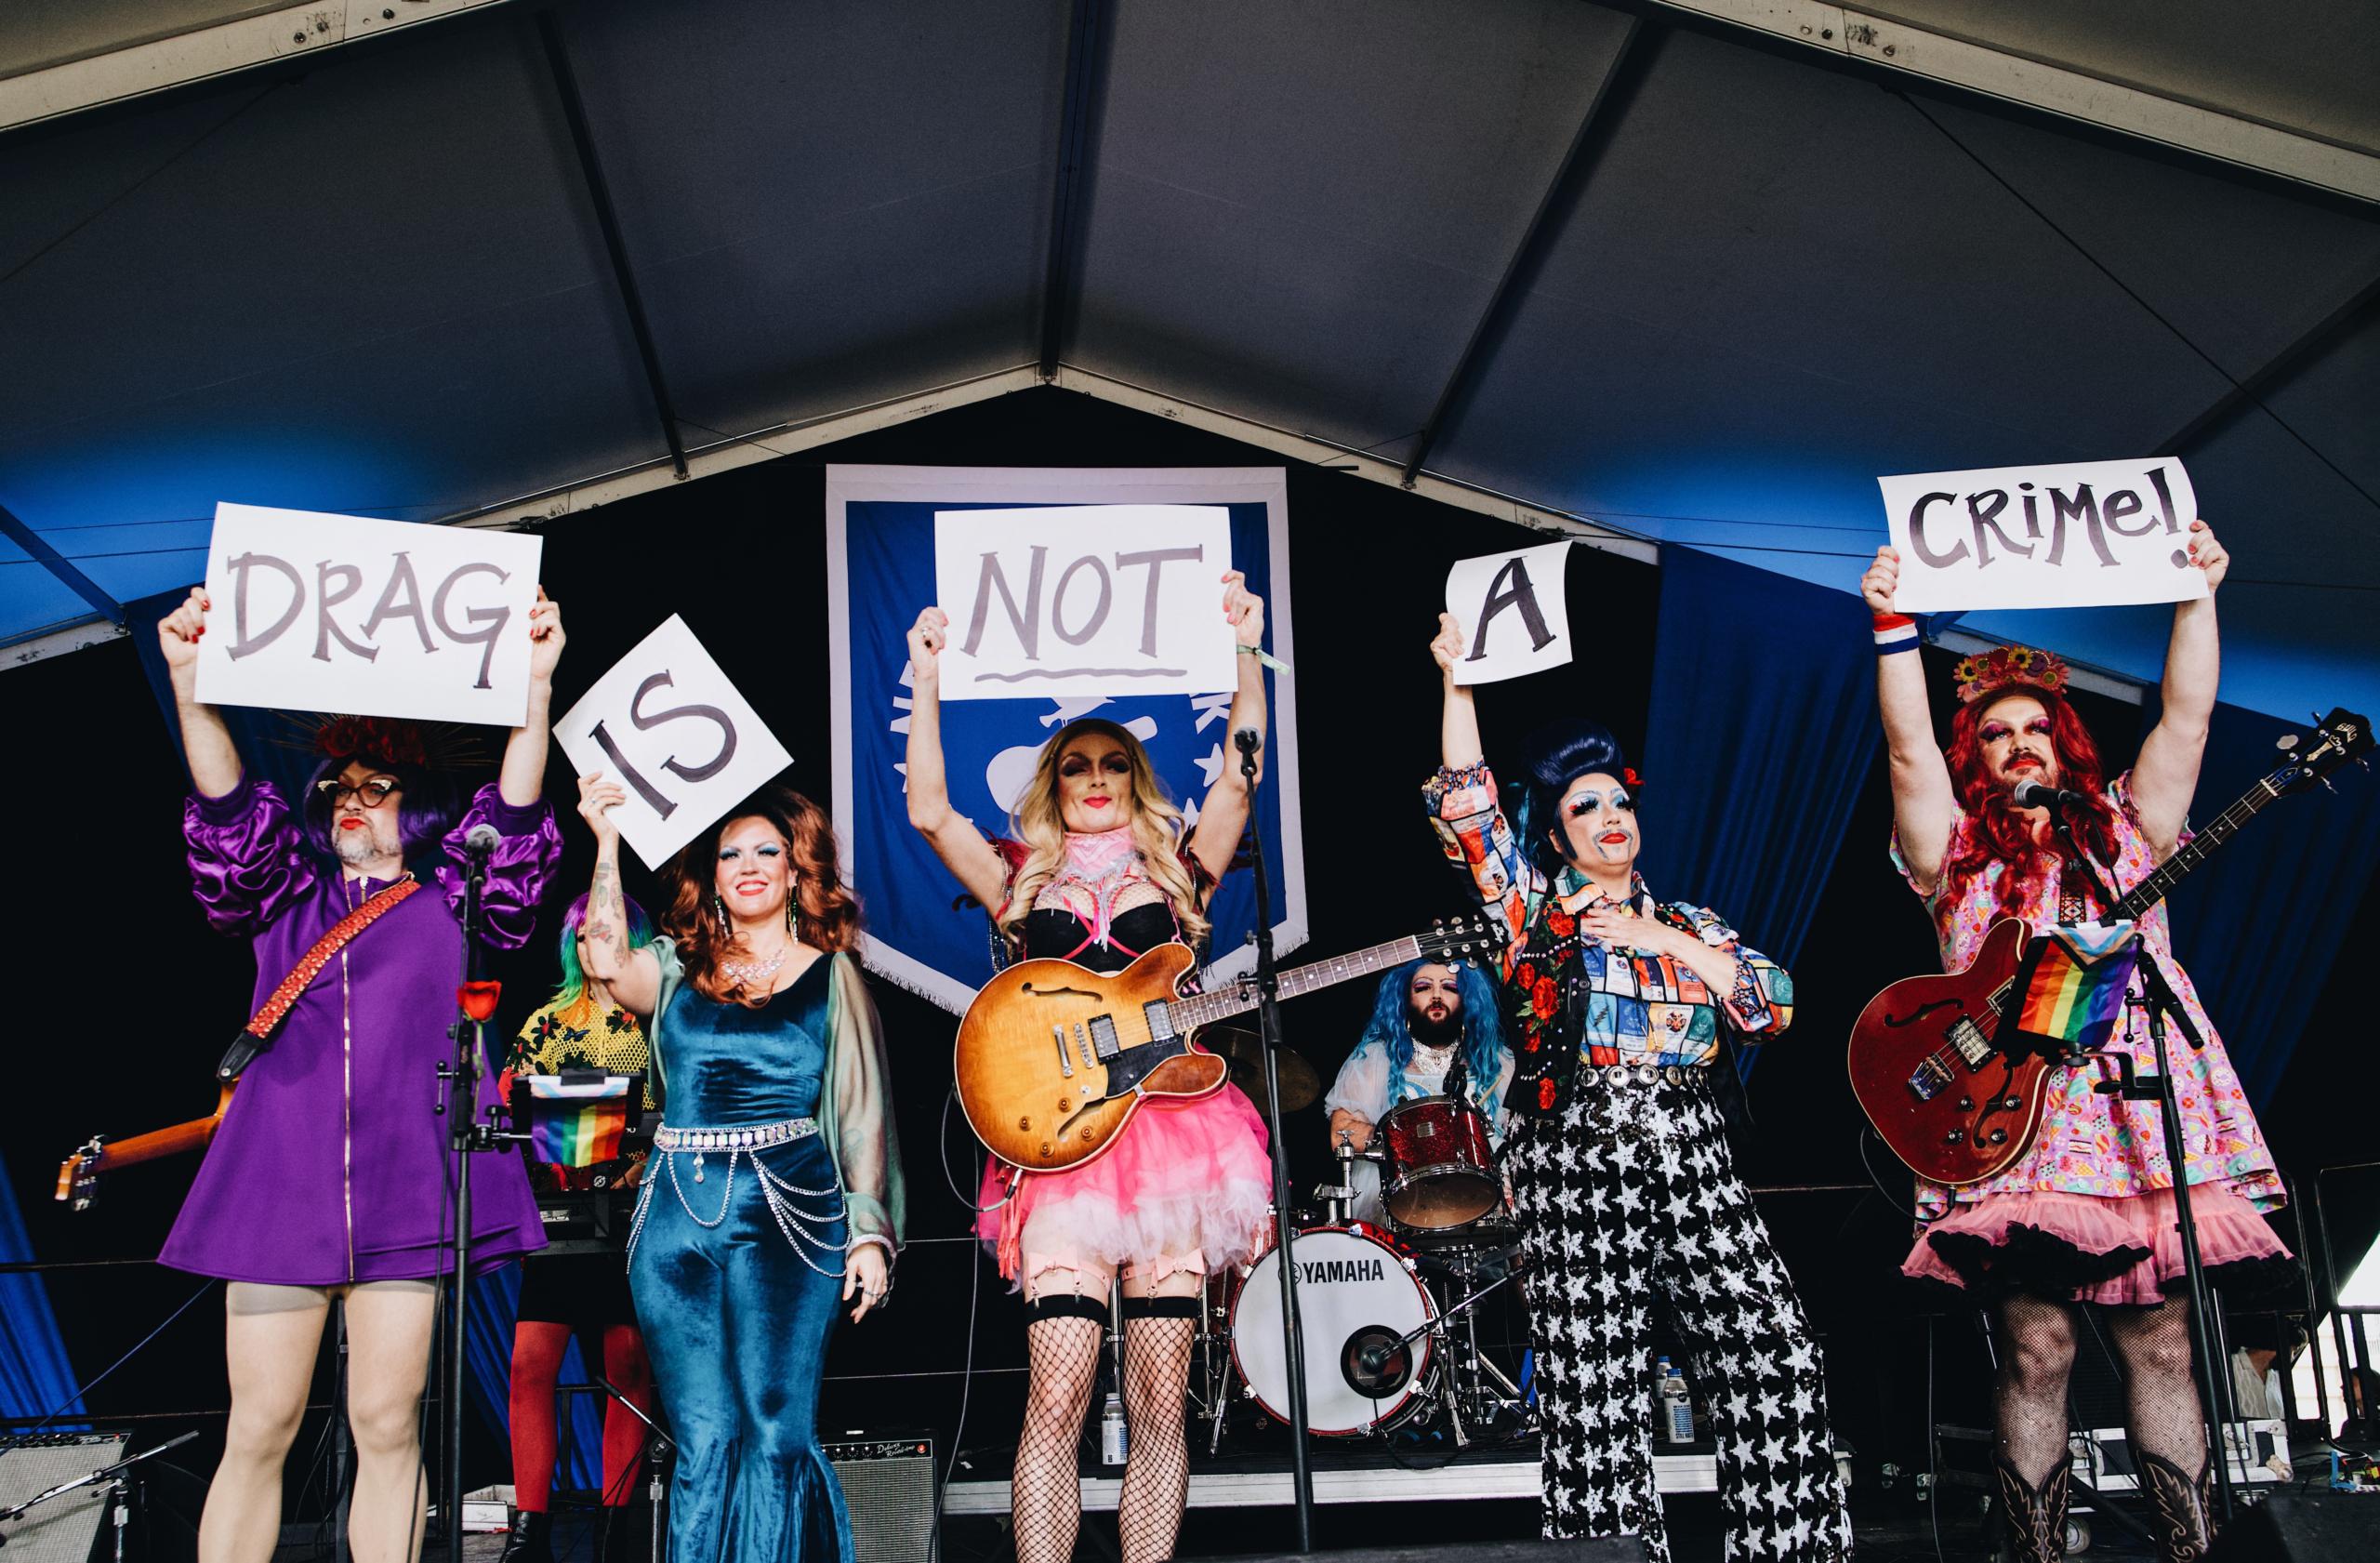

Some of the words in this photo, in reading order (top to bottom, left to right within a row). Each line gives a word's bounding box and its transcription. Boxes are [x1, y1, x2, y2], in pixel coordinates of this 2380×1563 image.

[225, 550, 511, 690] DRAG
[959, 543, 1204, 661] NOT
[1464, 554, 1557, 663] A
[588, 669, 738, 822] IS
[1302, 1259, 1384, 1284] YAMAHA
